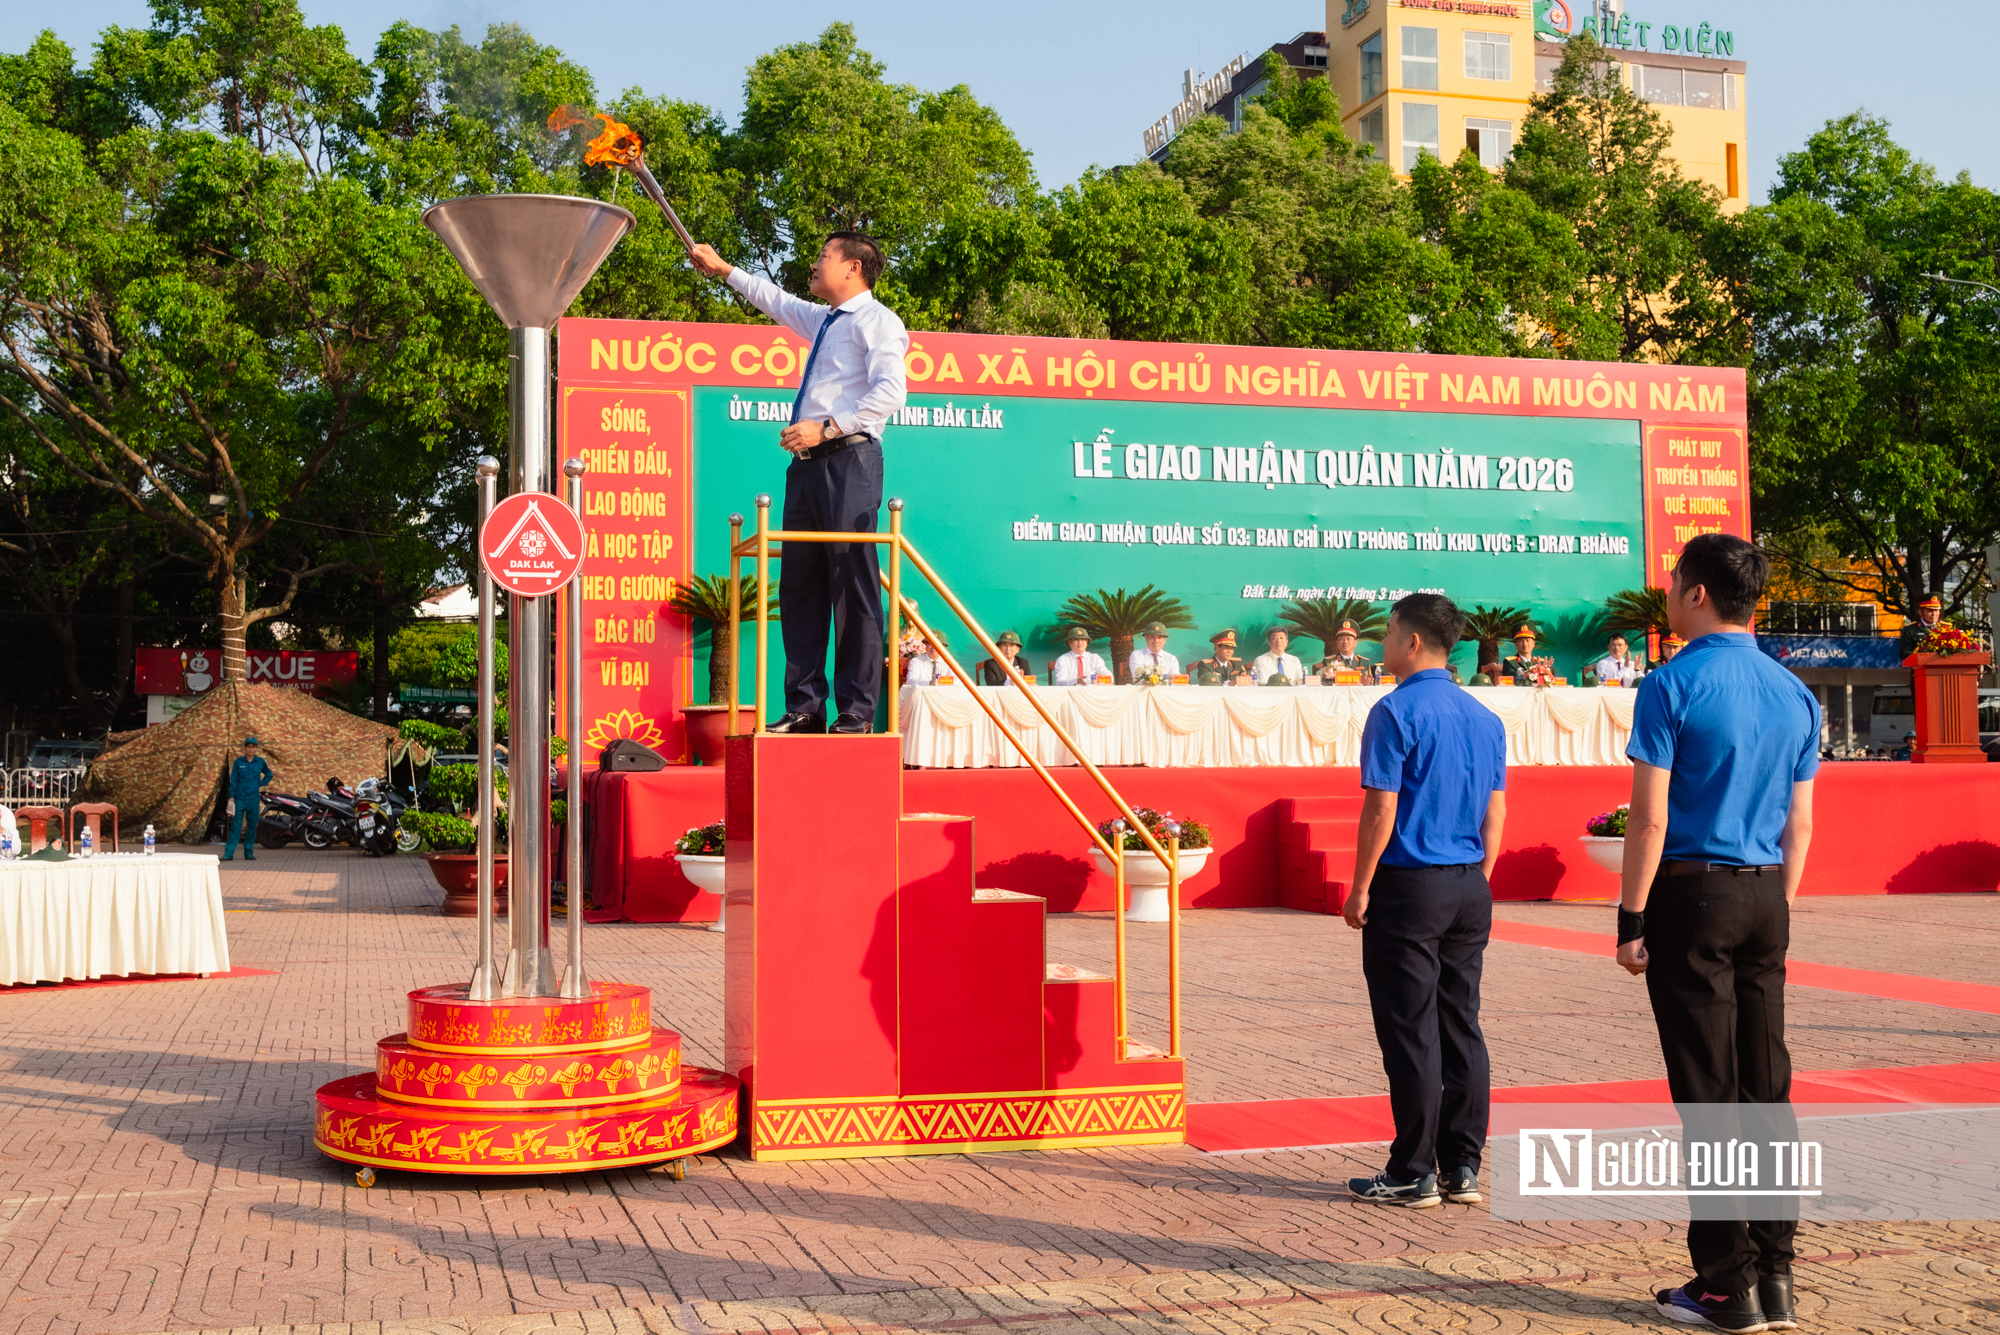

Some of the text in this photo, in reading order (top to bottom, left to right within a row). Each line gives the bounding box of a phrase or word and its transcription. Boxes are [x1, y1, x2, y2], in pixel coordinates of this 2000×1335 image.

[1584, 12, 1734, 58] BIỆT ĐIỆN
[591, 332, 1725, 412] NƯỚC CỘ ÒA XÃ HỘI CHỦ NGHĨA VIỆT NAM MUÔN NĂM
[600, 399, 651, 436] SỐNG,
[729, 394, 752, 420] ỦY
[757, 402, 792, 422] BAN
[933, 402, 966, 427] ĐẮK
[971, 403, 1003, 428] LẮK
[580, 441, 672, 478] CHIẾN ĐẤU,
[1074, 427, 1574, 492] LỄ GIAO NHẬN QUÂN NĂM 2026
[1668, 436, 1722, 458] PHÁT HUY
[1655, 463, 1737, 487] TRUYỀN THỐNG
[585, 486, 666, 522] LAO ĐỘNG
[1664, 493, 1731, 518] QUÊ HƯƠNG,
[604, 533, 637, 564] HỌC
[642, 529, 674, 564] TẬP
[1013, 514, 1053, 541] ĐIỂM
[1059, 522, 1096, 542] GIAO
[1101, 521, 1146, 547] NHẬN
[1152, 522, 1195, 547] QUÂN
[1201, 521, 1223, 545] SỐ
[1227, 527, 1251, 547] 03:
[1256, 528, 1288, 547] BAN
[1293, 524, 1318, 549] CHỈ
[1323, 529, 1352, 549] HUY
[1358, 527, 1408, 551] PHÒNG
[1413, 527, 1442, 551] THỦ
[1447, 533, 1477, 552] KHU
[1481, 532, 1511, 556] VỰC
[1539, 534, 1574, 554] DRAY
[1580, 532, 1629, 555] BHĂNG
[510, 560, 555, 569] DAK LAK
[582, 574, 677, 602] HEO GƯƠNG
[1242, 584, 1265, 598] Đắk
[1269, 585, 1294, 600] Lắk,
[1296, 586, 1325, 602] ngày
[1327, 586, 1342, 600] 04
[1345, 587, 1376, 602] tháng
[1378, 587, 1388, 600] 3
[595, 610, 656, 643] BÁC HỒ
[220, 656, 315, 680] IXUE
[1789, 648, 1848, 659] VIETABANK
[601, 656, 649, 692] VĨ ĐẠI
